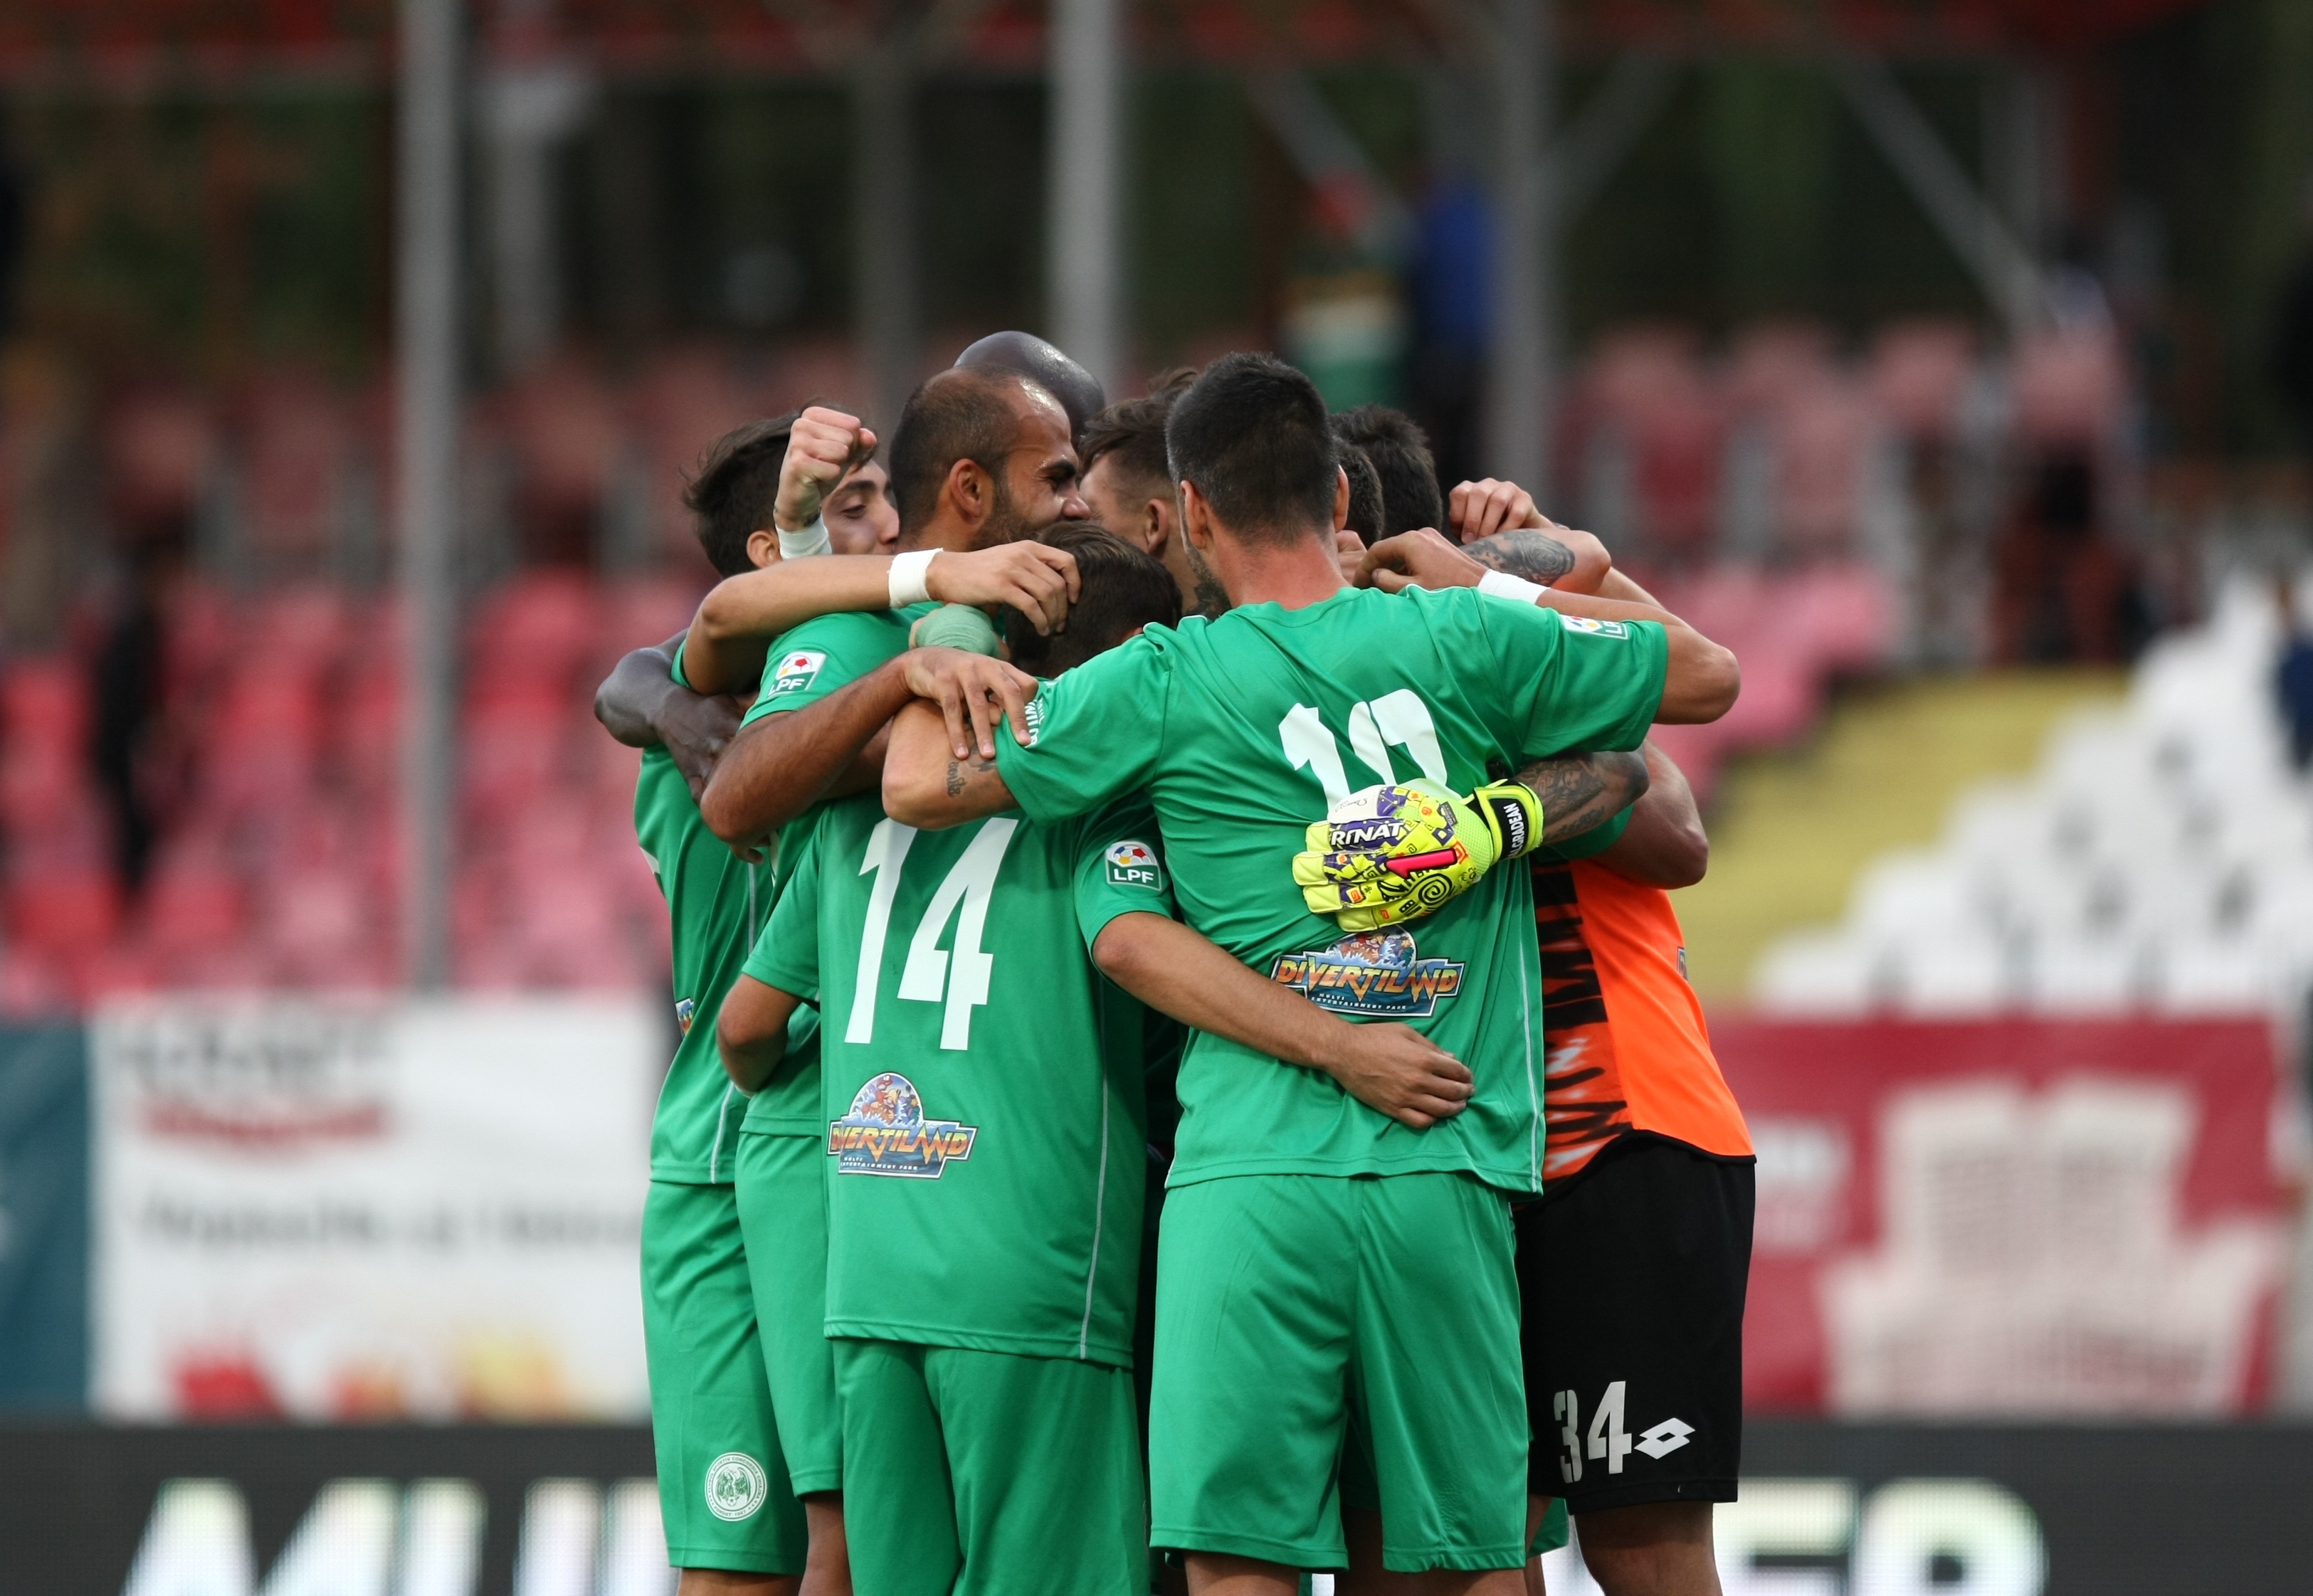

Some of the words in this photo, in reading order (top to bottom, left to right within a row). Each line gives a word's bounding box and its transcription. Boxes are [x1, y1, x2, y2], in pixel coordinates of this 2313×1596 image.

[1603, 620, 1623, 635] LP
[768, 678, 805, 697] LPF
[1331, 822, 1405, 846] RINAT
[1114, 868, 1154, 884] LPF
[844, 817, 1018, 1050] 14
[1276, 956, 1459, 1003] DIVERTILAND
[831, 1122, 969, 1165] DVERTILAND
[1554, 1380, 1632, 1484] 34
